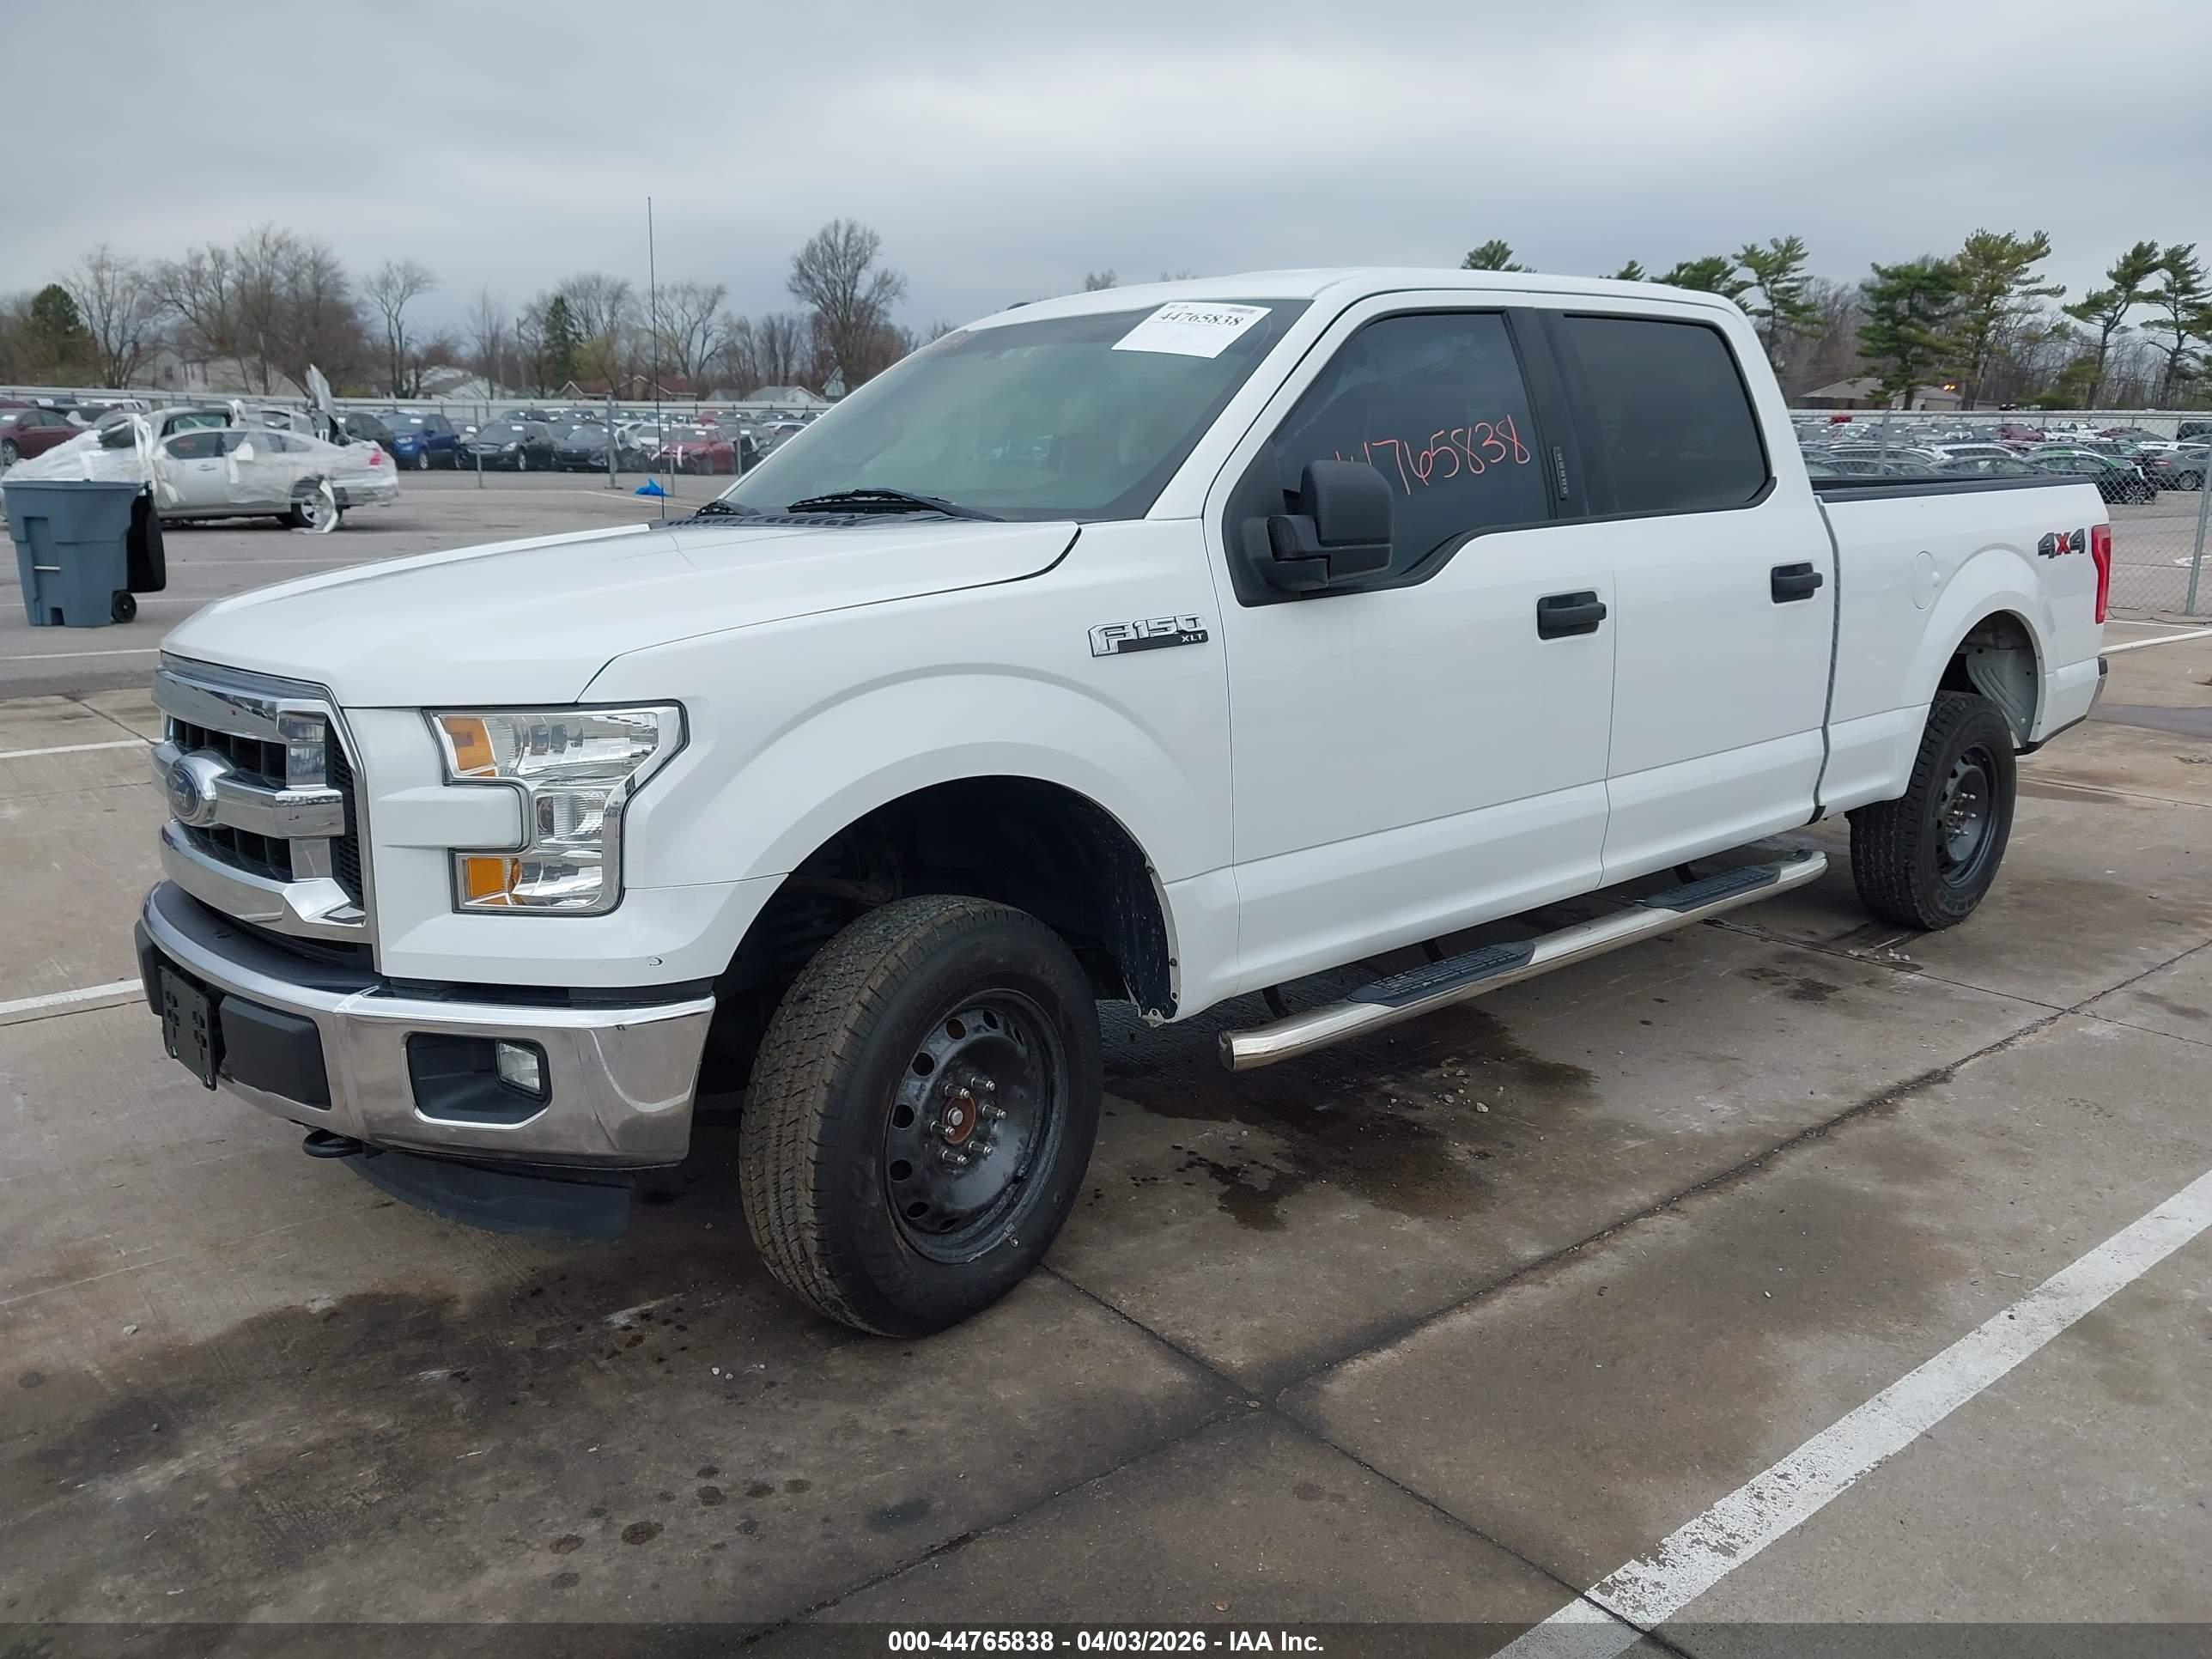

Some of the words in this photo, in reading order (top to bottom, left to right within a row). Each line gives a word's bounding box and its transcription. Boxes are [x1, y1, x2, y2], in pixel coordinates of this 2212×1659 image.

[1159, 311, 1244, 326] 44765838
[1334, 414, 1531, 495] 765838
[1181, 632, 1204, 643] XLT
